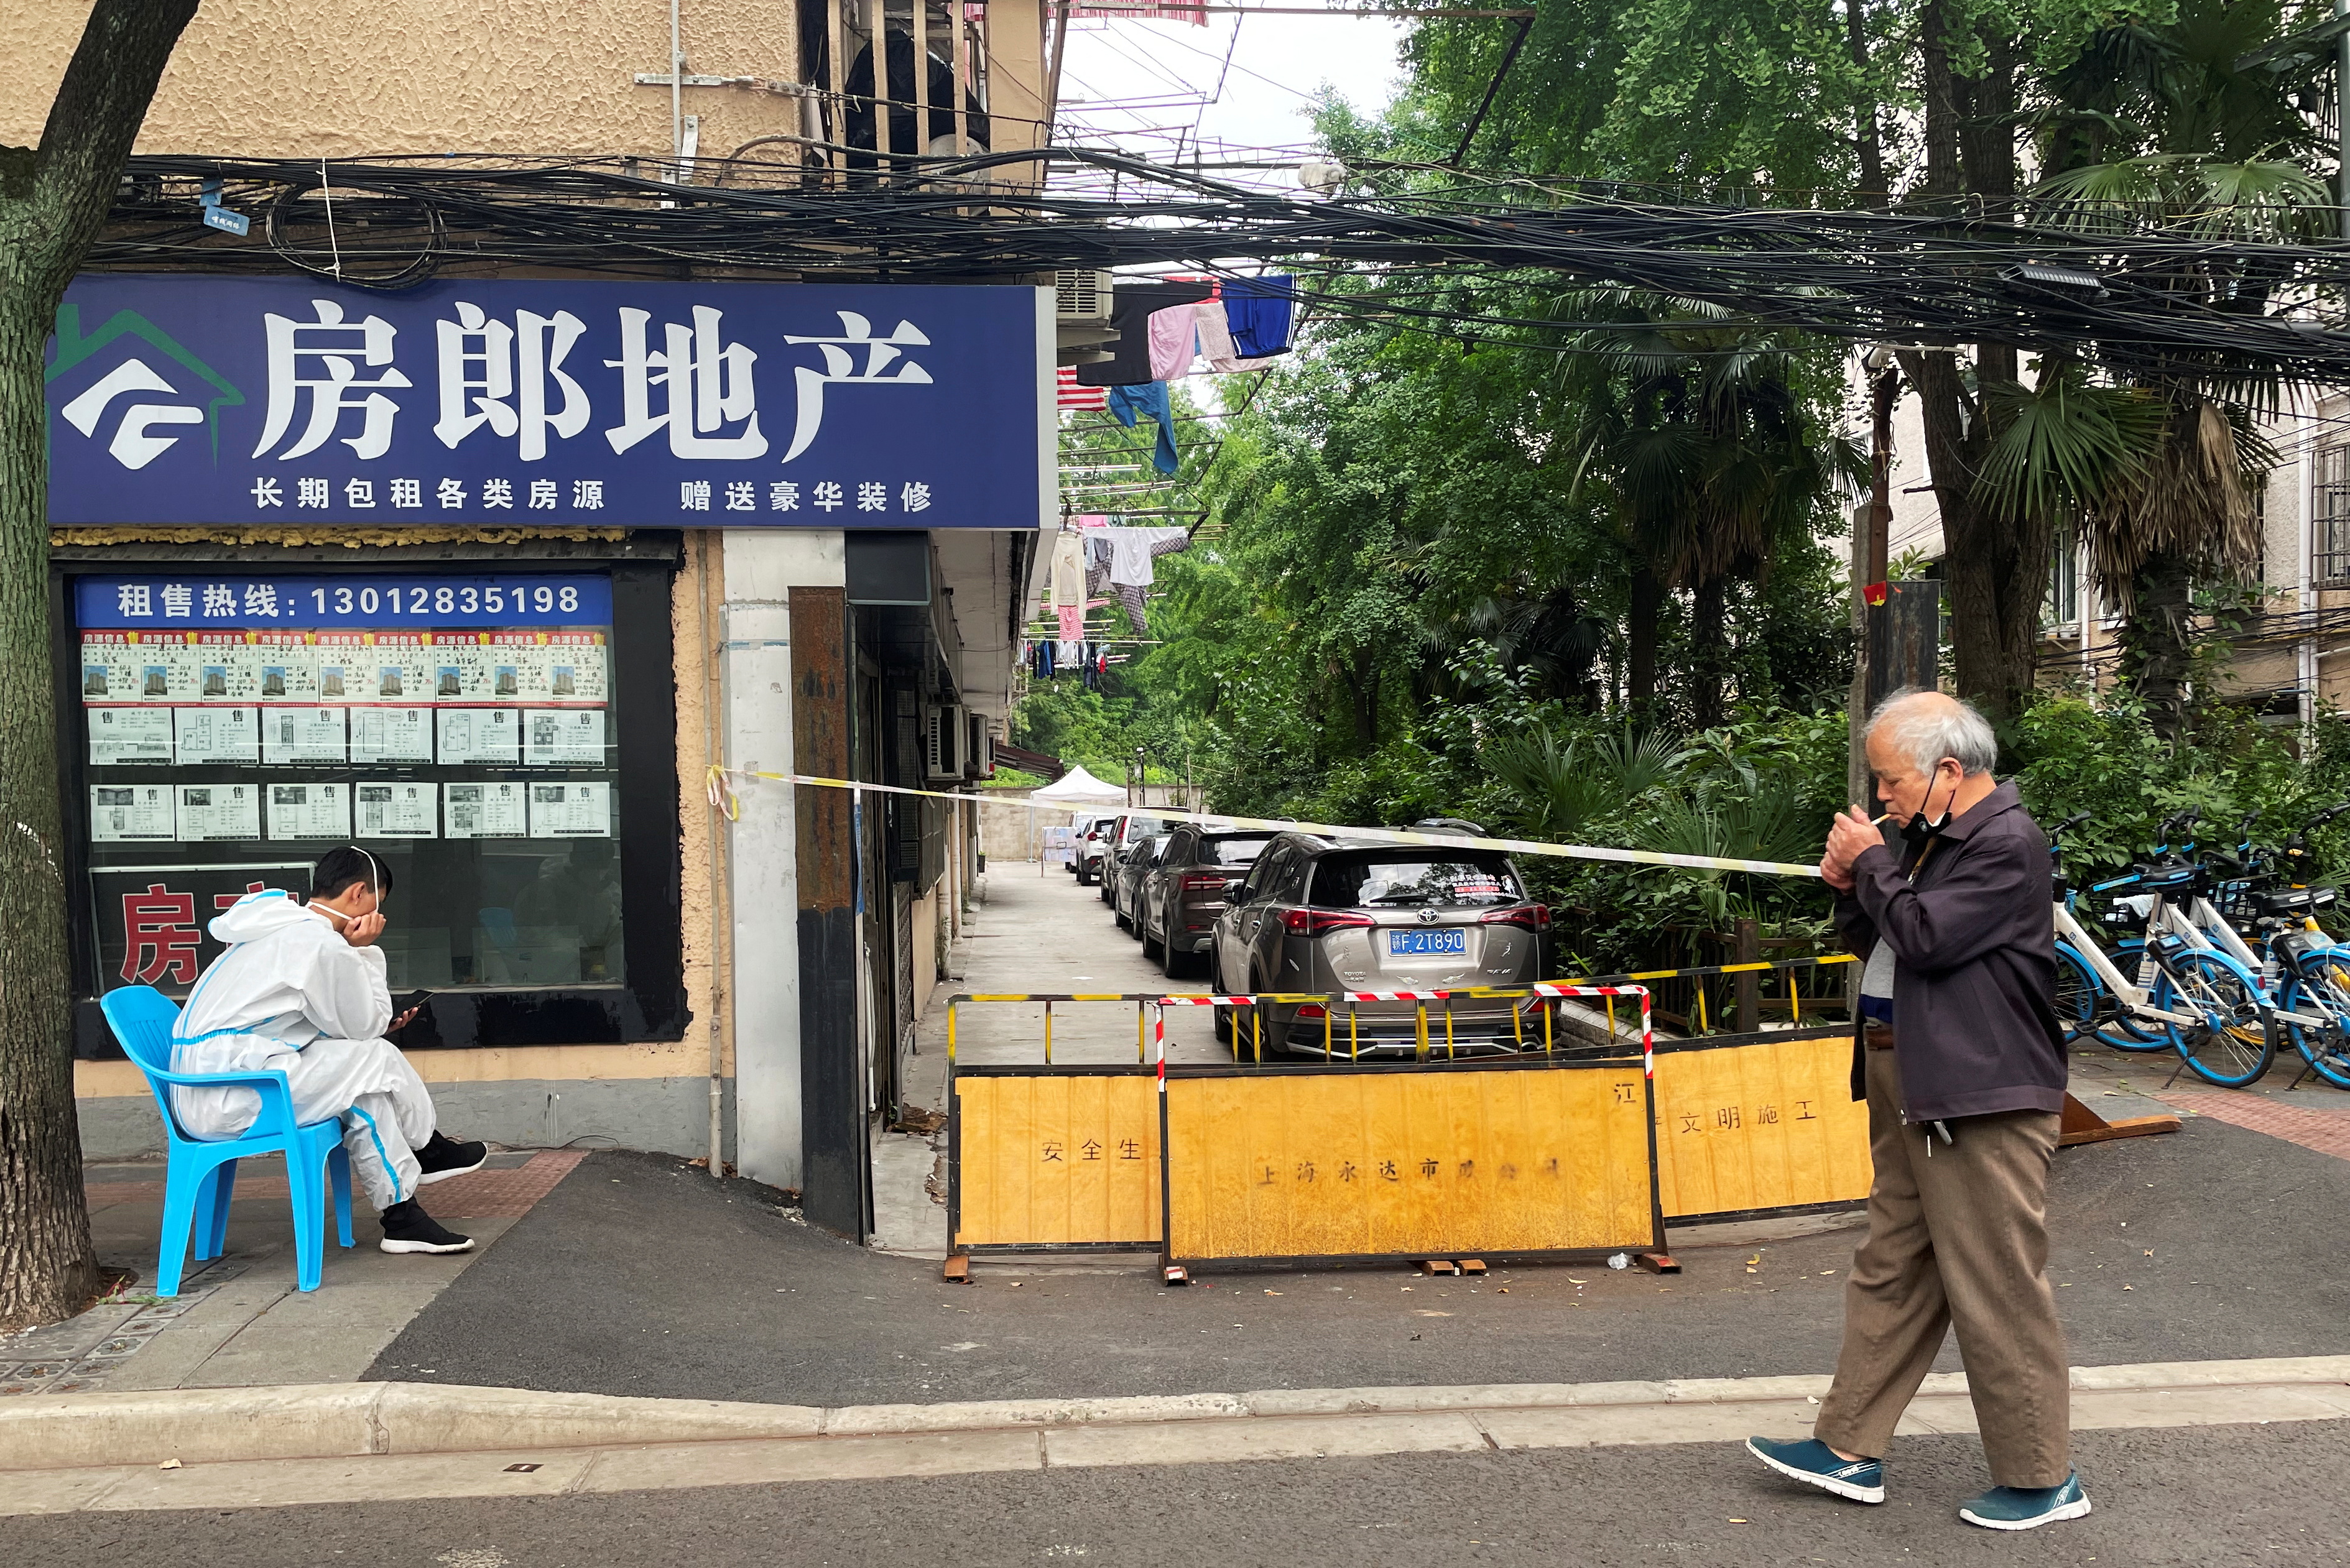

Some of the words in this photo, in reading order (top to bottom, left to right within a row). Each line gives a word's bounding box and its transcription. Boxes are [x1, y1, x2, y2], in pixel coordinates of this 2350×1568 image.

[252, 300, 933, 464] 房郎地产
[251, 477, 604, 510] 长期包租各类房源
[681, 480, 932, 512] 赠送豪华装修
[379, 635, 419, 645] 房源信息
[437, 635, 476, 645] 房源信息
[494, 635, 534, 645] 房源信息
[552, 635, 591, 645] 房源信息
[1042, 1139, 1141, 1162] 安全生
